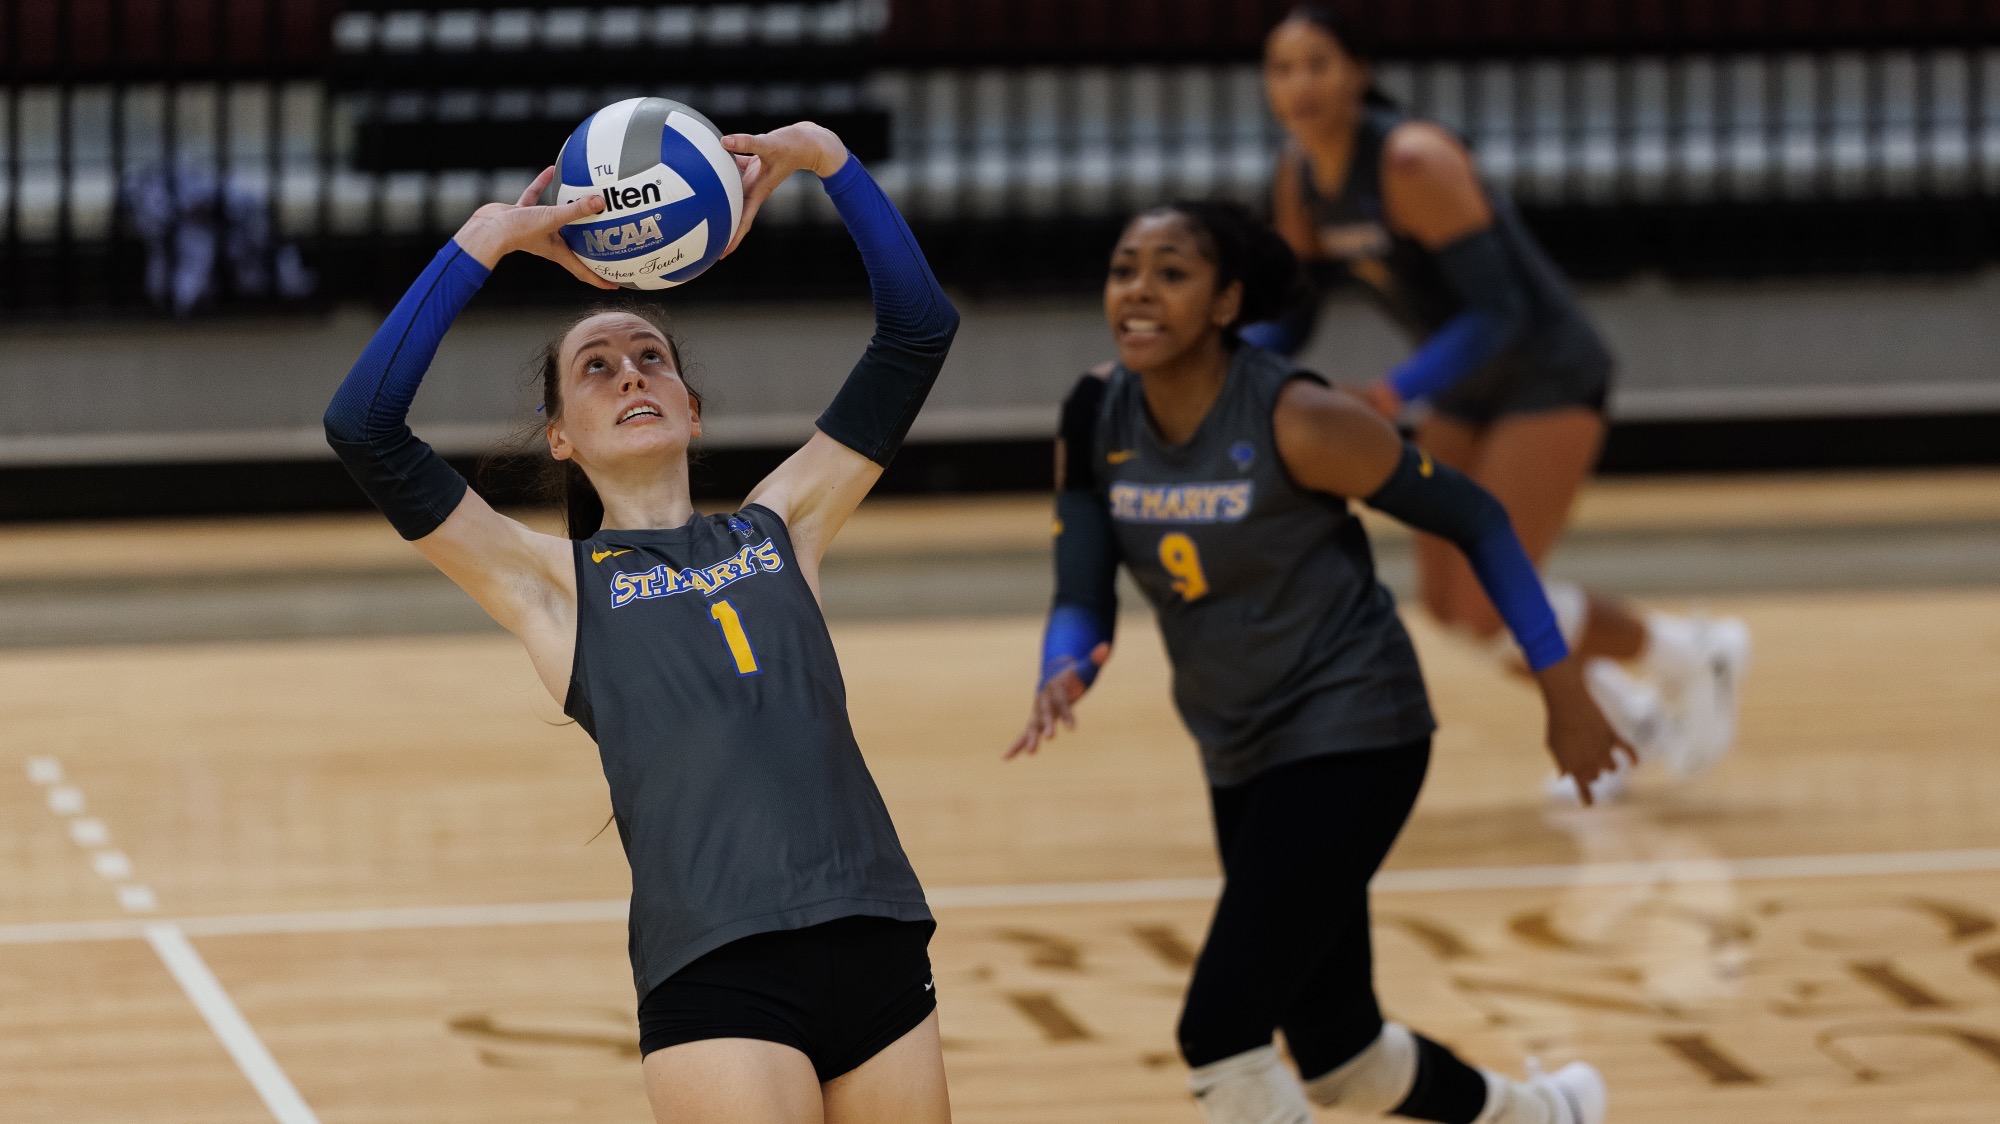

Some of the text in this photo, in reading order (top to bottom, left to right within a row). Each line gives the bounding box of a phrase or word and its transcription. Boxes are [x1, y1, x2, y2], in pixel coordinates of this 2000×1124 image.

[567, 183, 661, 214] lten
[583, 216, 663, 253] NCAA
[594, 248, 684, 280] Super Touch
[1158, 531, 1209, 602] 9
[706, 598, 763, 679] 1
